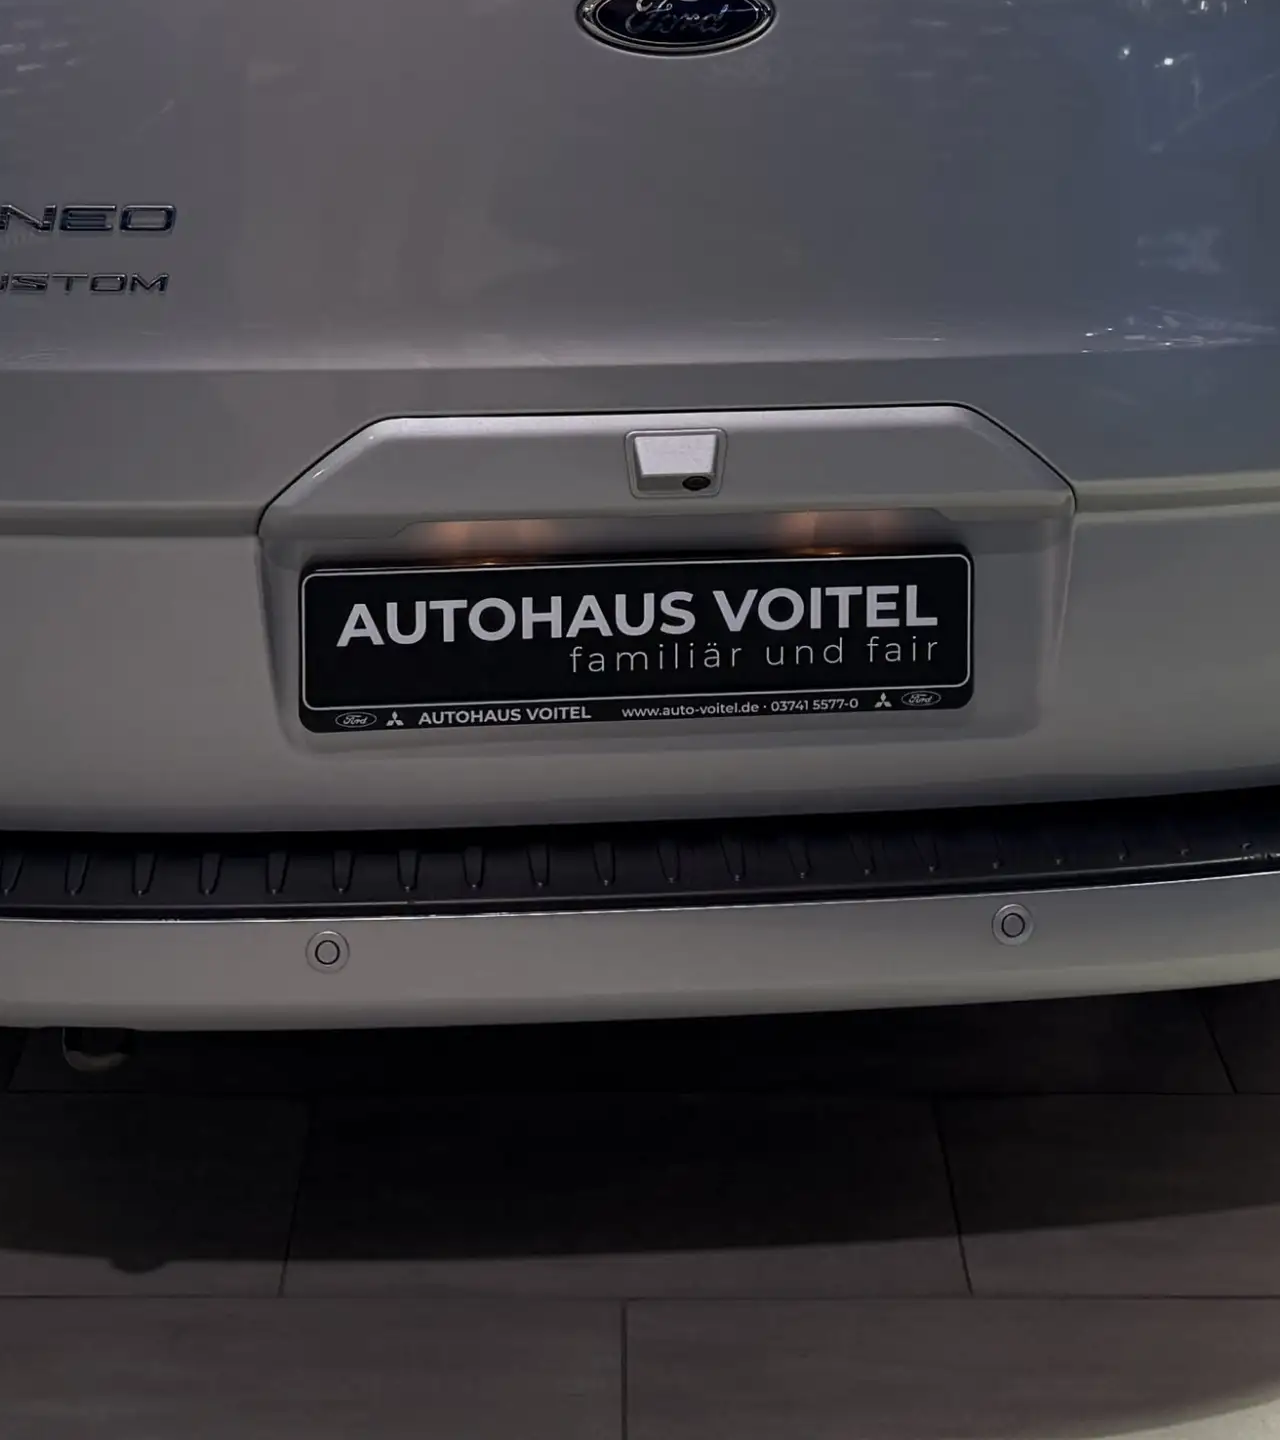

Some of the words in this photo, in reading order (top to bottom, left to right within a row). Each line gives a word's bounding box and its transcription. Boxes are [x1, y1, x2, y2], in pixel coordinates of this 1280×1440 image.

[336, 589, 696, 648] AUTOHAUS
[712, 583, 938, 632] VOITEL
[570, 641, 742, 675] familiär
[765, 636, 844, 666] und
[866, 636, 938, 665] fair
[418, 707, 522, 727] AUTOHAUS
[526, 705, 592, 722] VOITEL
[621, 700, 759, 718] www.auto-voitel.de
[770, 699, 809, 712] 03741
[813, 697, 859, 711] 5577-0
